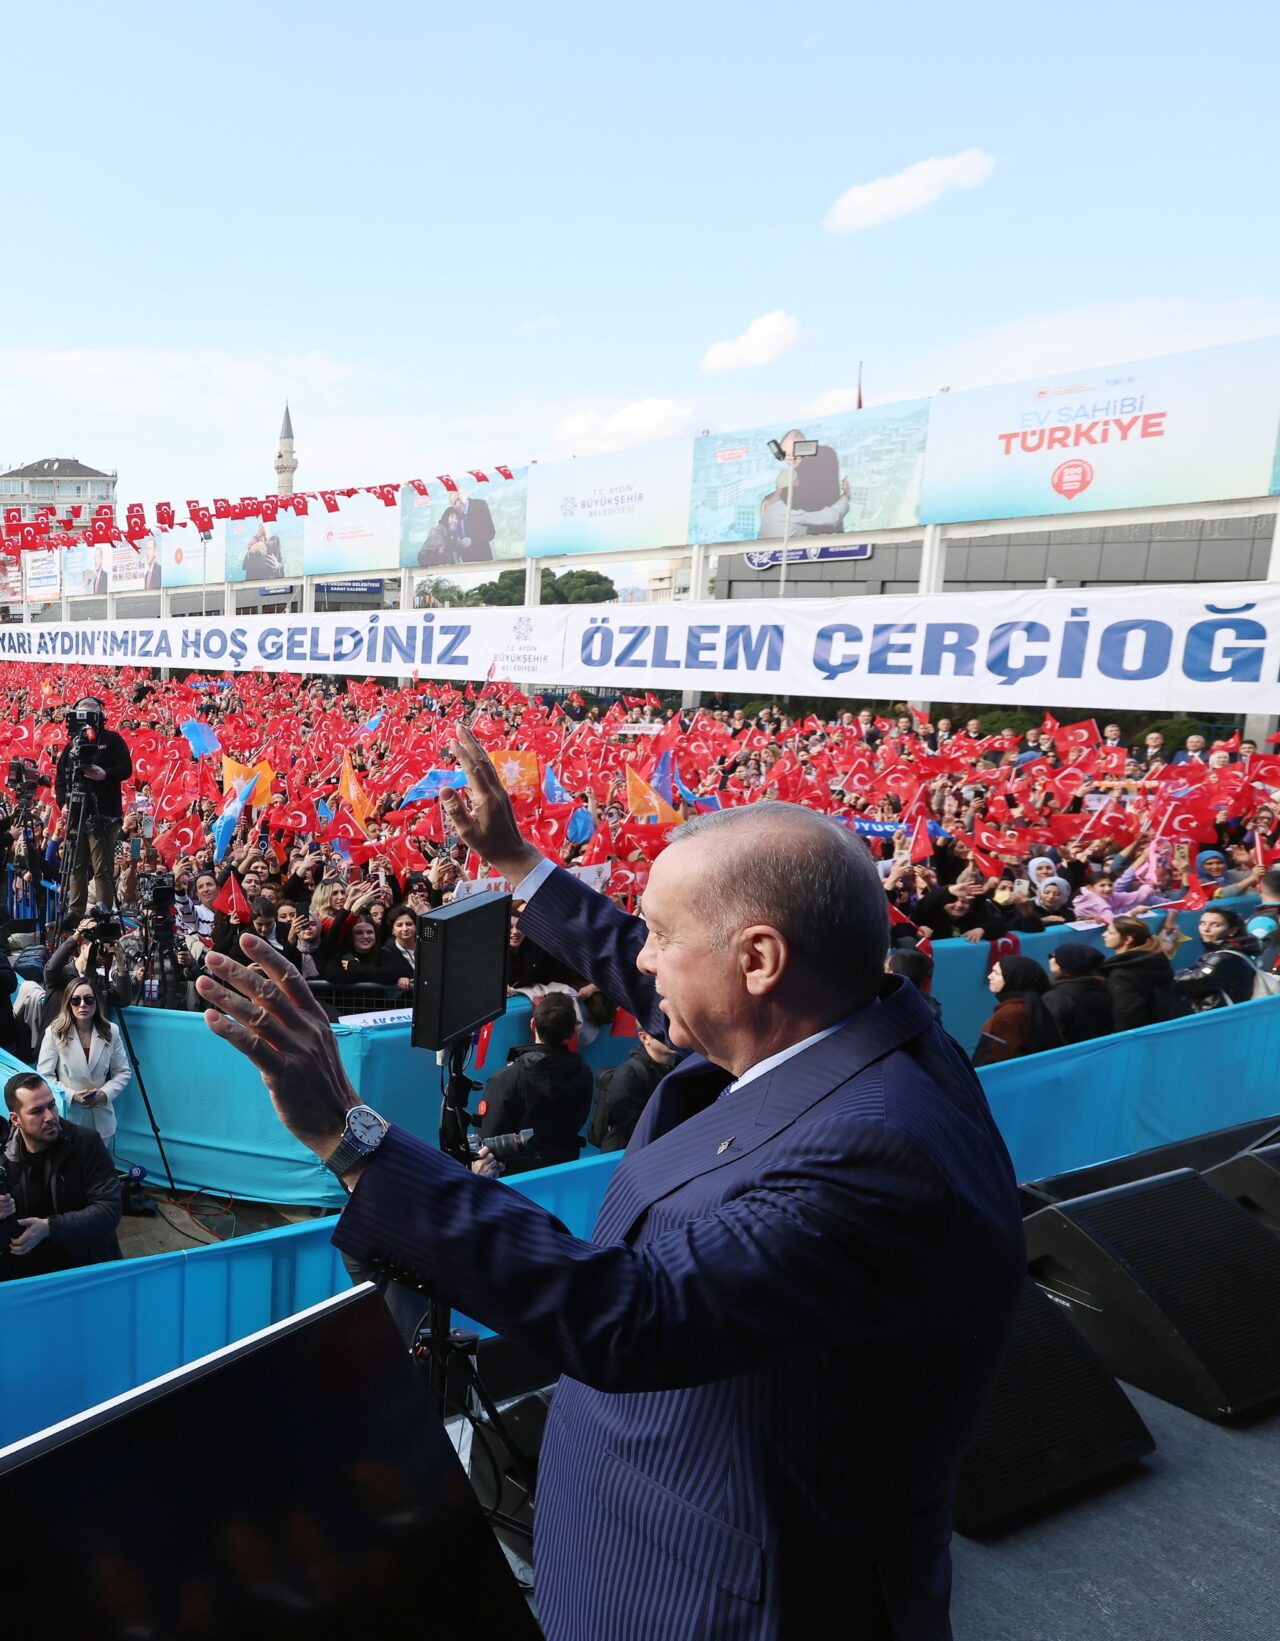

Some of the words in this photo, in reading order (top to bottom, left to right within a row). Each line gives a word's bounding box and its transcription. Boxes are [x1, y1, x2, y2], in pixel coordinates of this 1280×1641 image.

[1020, 409, 1052, 429] EV
[181, 628, 248, 667] HOŞ
[257, 613, 472, 665] GELDİNİZ
[580, 616, 785, 672] ÖZLEM
[812, 602, 1280, 685] ÇERÇİOĞ
